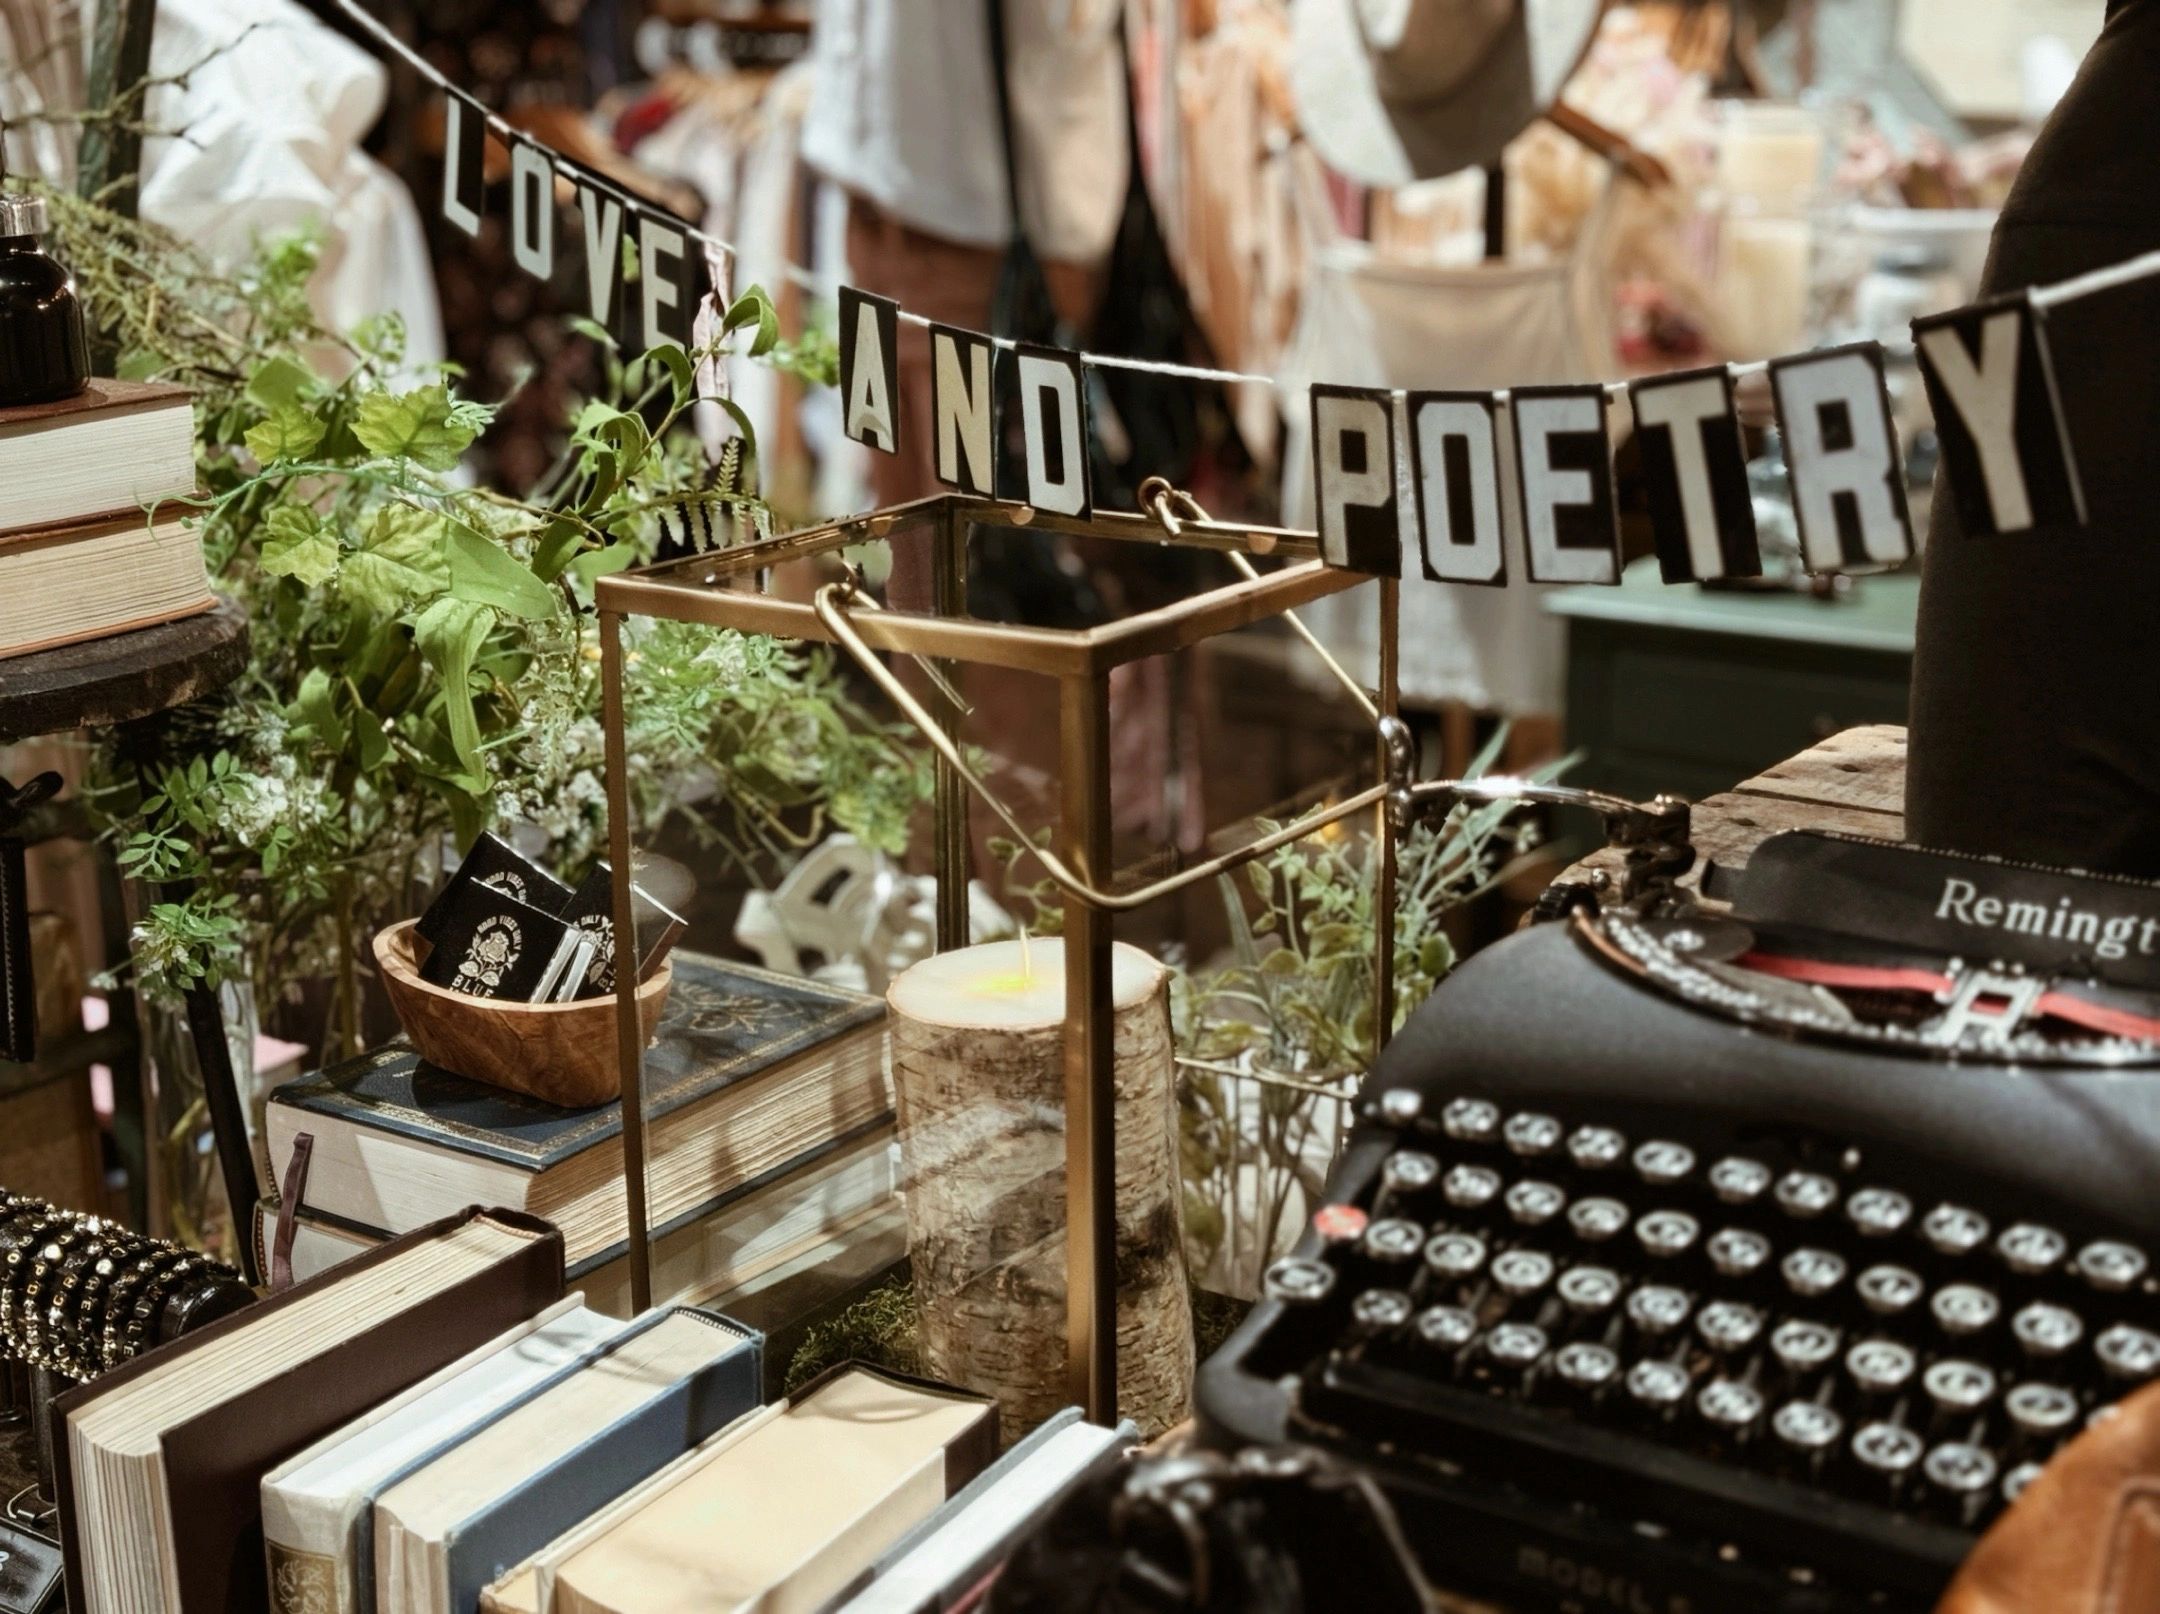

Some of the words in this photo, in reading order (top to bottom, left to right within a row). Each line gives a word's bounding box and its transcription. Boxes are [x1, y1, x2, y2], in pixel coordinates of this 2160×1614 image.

[443, 95, 685, 354] LOVE
[846, 302, 1085, 515] AND
[1316, 310, 2033, 584] POETRY
